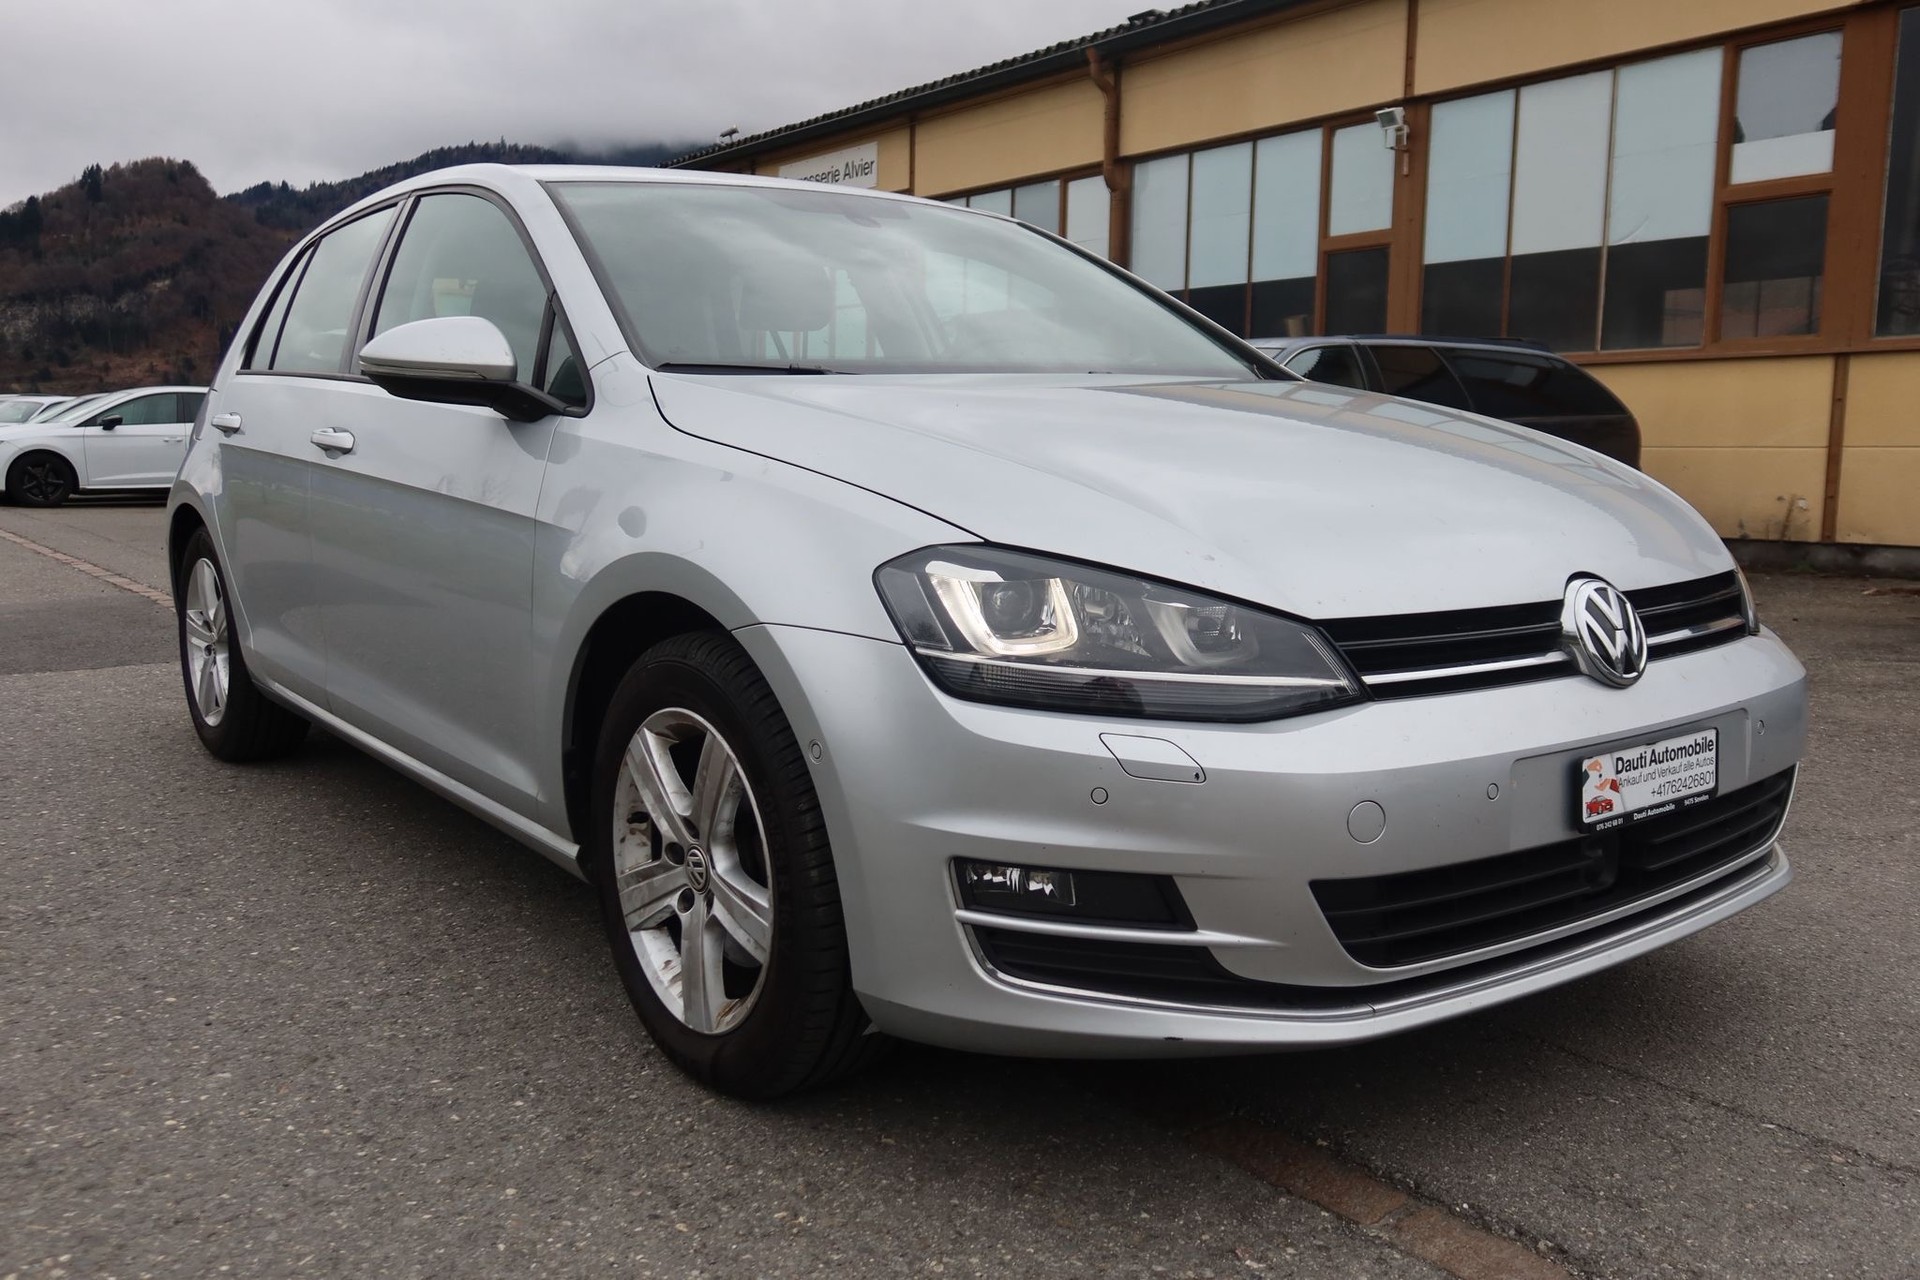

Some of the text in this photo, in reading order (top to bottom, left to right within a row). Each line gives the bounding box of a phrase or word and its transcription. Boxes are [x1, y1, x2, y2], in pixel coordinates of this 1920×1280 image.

[843, 158, 875, 180] Alvier
[1615, 736, 1714, 775] Dauti Automobile
[1618, 756, 1715, 787] Ankauf und Verkauf alle Autos
[1651, 770, 1715, 797] +41762426801
[1633, 803, 1676, 820] Dauti Automobile
